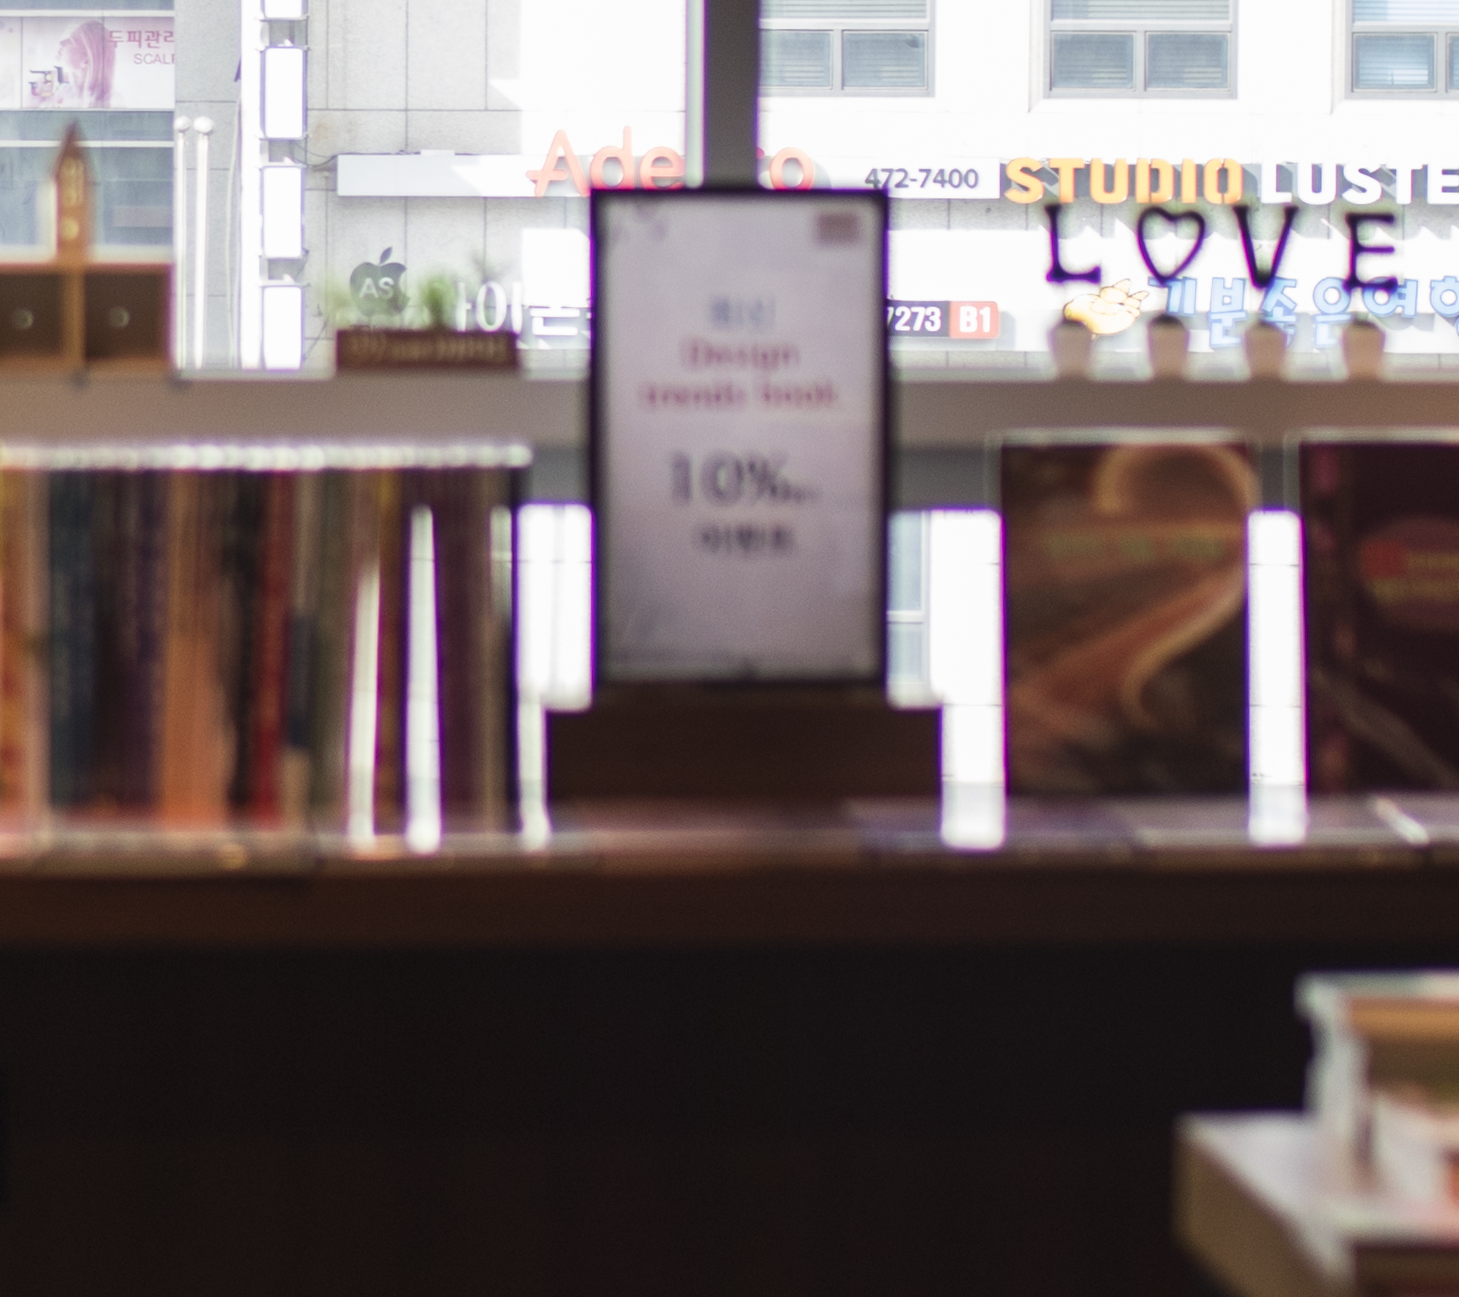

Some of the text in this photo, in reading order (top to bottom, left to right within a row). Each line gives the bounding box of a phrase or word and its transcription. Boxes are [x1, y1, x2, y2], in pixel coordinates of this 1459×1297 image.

[525, 125, 815, 197] Adeo
[866, 167, 980, 191] 472-7400
[1005, 156, 1243, 206] STUDIO
[359, 277, 395, 299] AS
[888, 305, 991, 333] 273 B1
[671, 452, 790, 503] 10%
